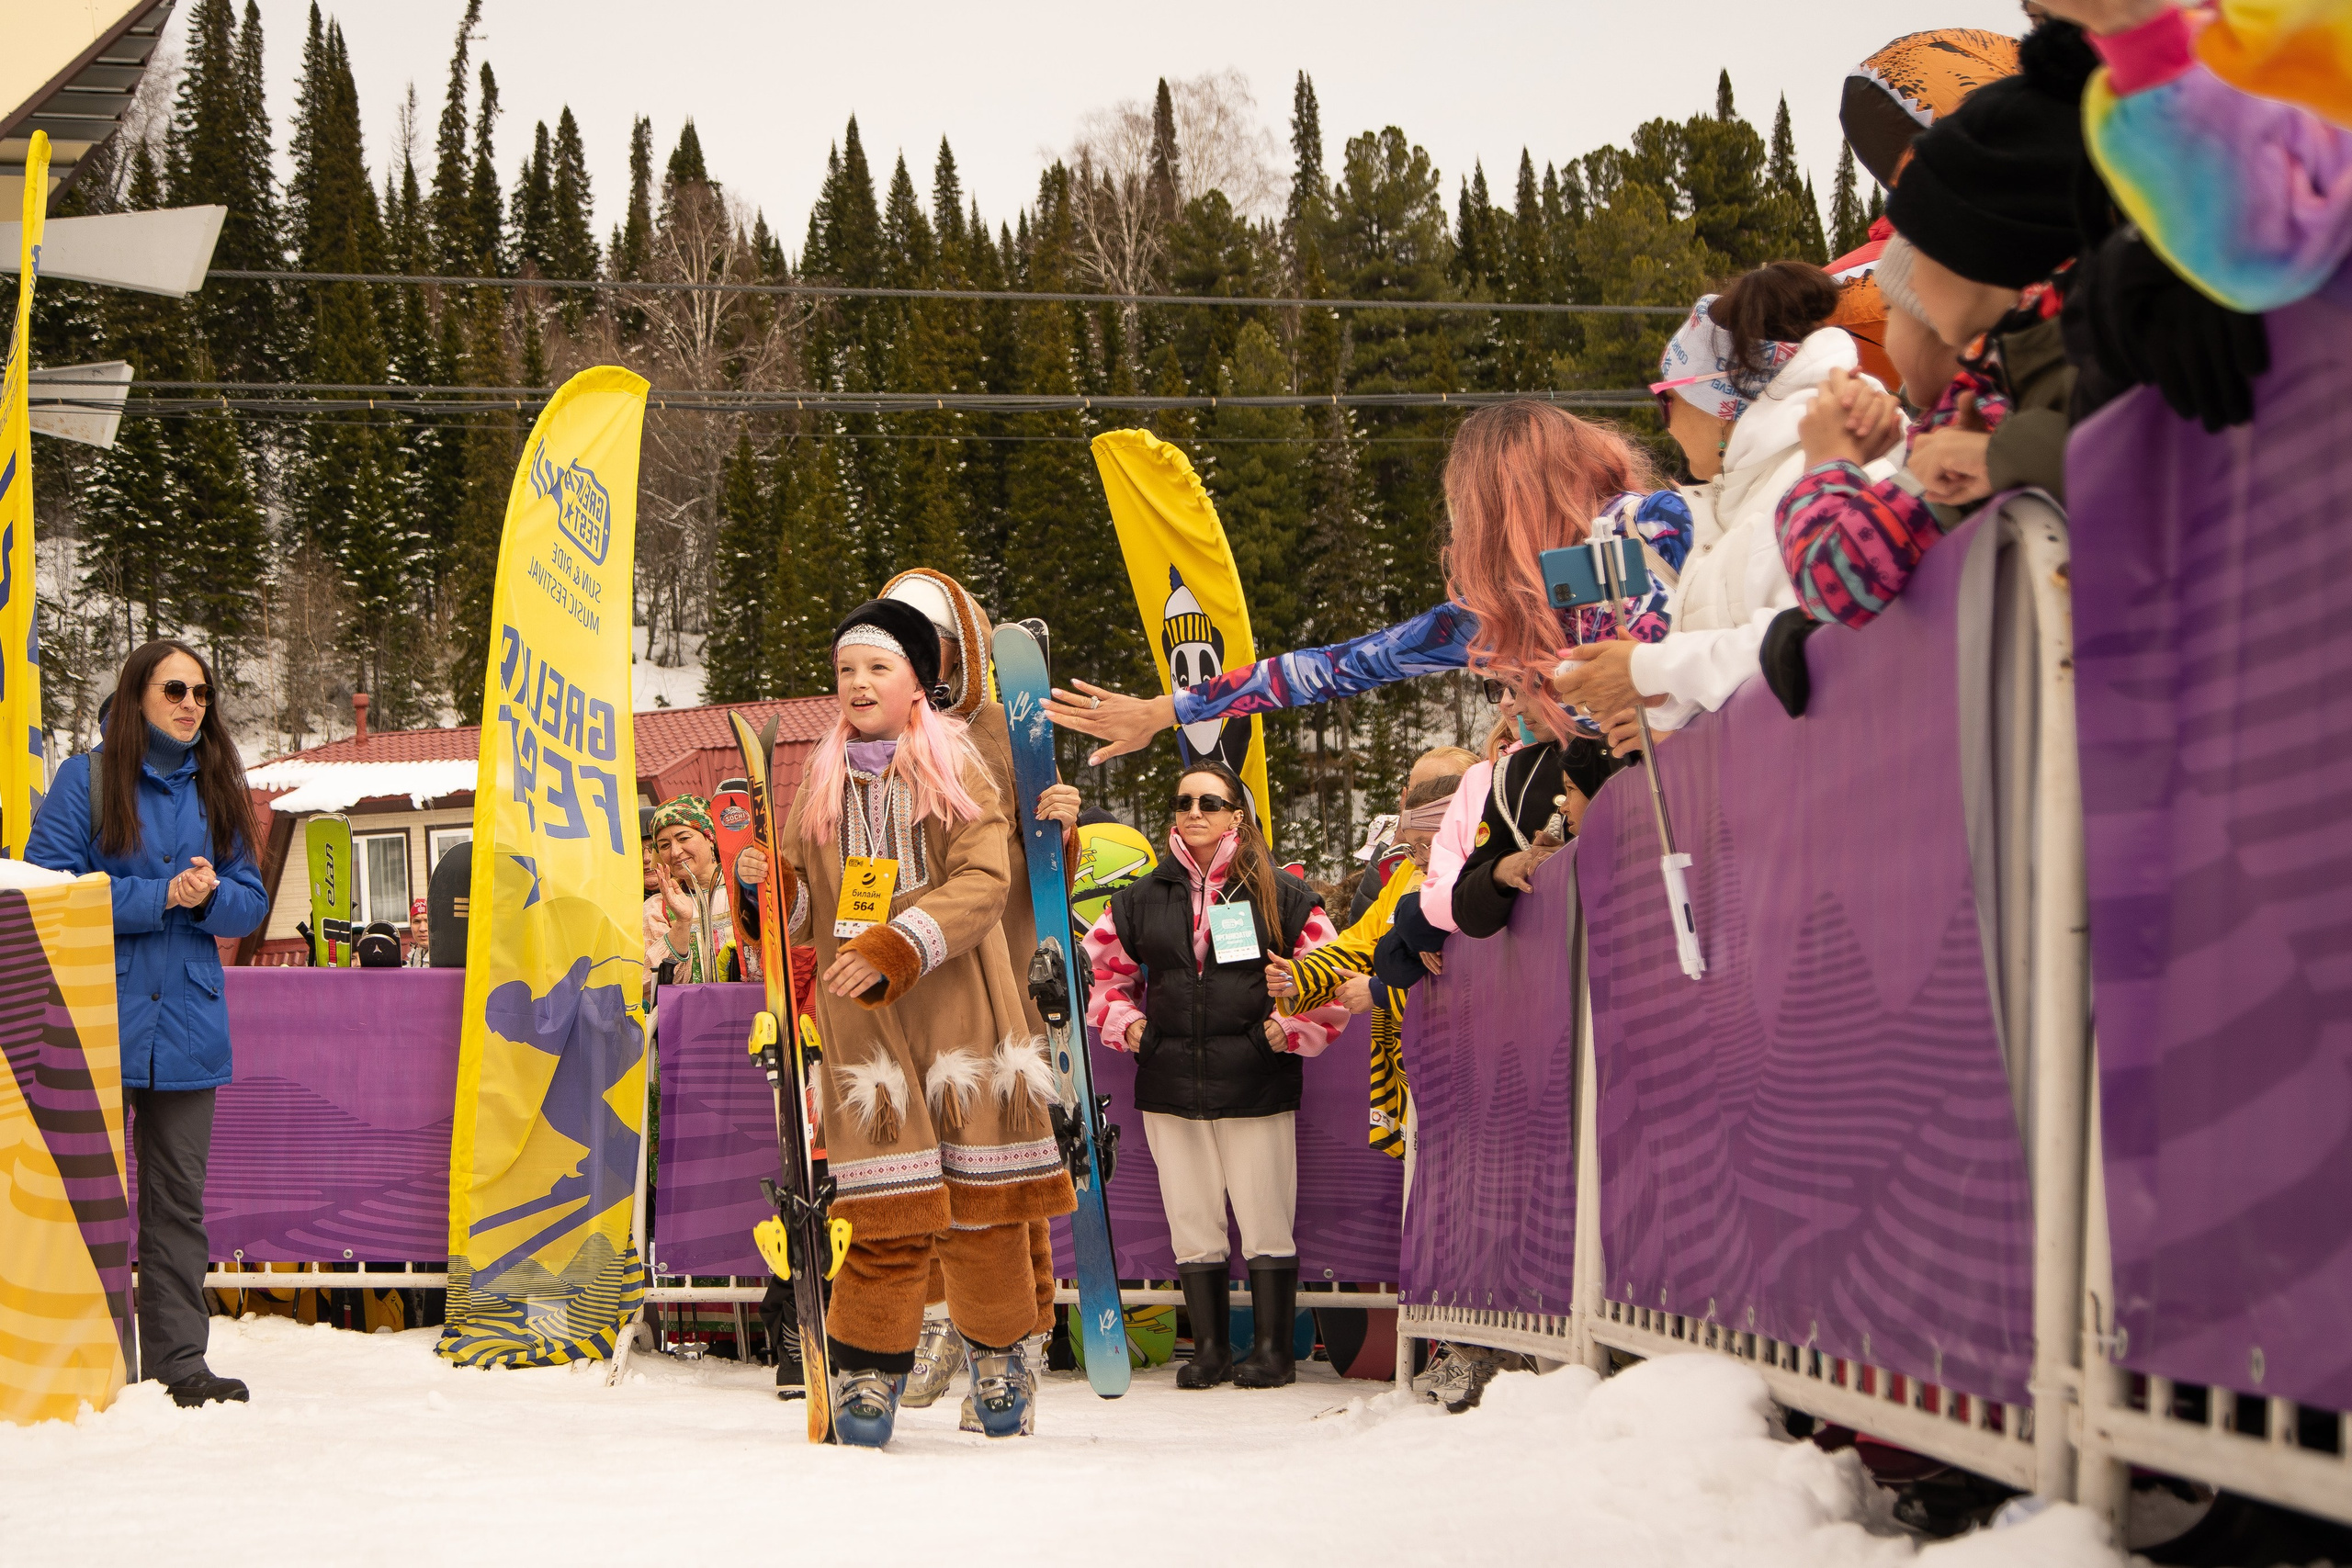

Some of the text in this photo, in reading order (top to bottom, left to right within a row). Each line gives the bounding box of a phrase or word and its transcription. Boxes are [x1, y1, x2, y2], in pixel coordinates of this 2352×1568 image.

[1008, 690, 1035, 731] K2
[725, 812, 746, 822] SOCHI
[324, 842, 336, 908] elan
[852, 888, 881, 899] билайн
[853, 900, 875, 912] 564
[1098, 1308, 1118, 1337] K2
